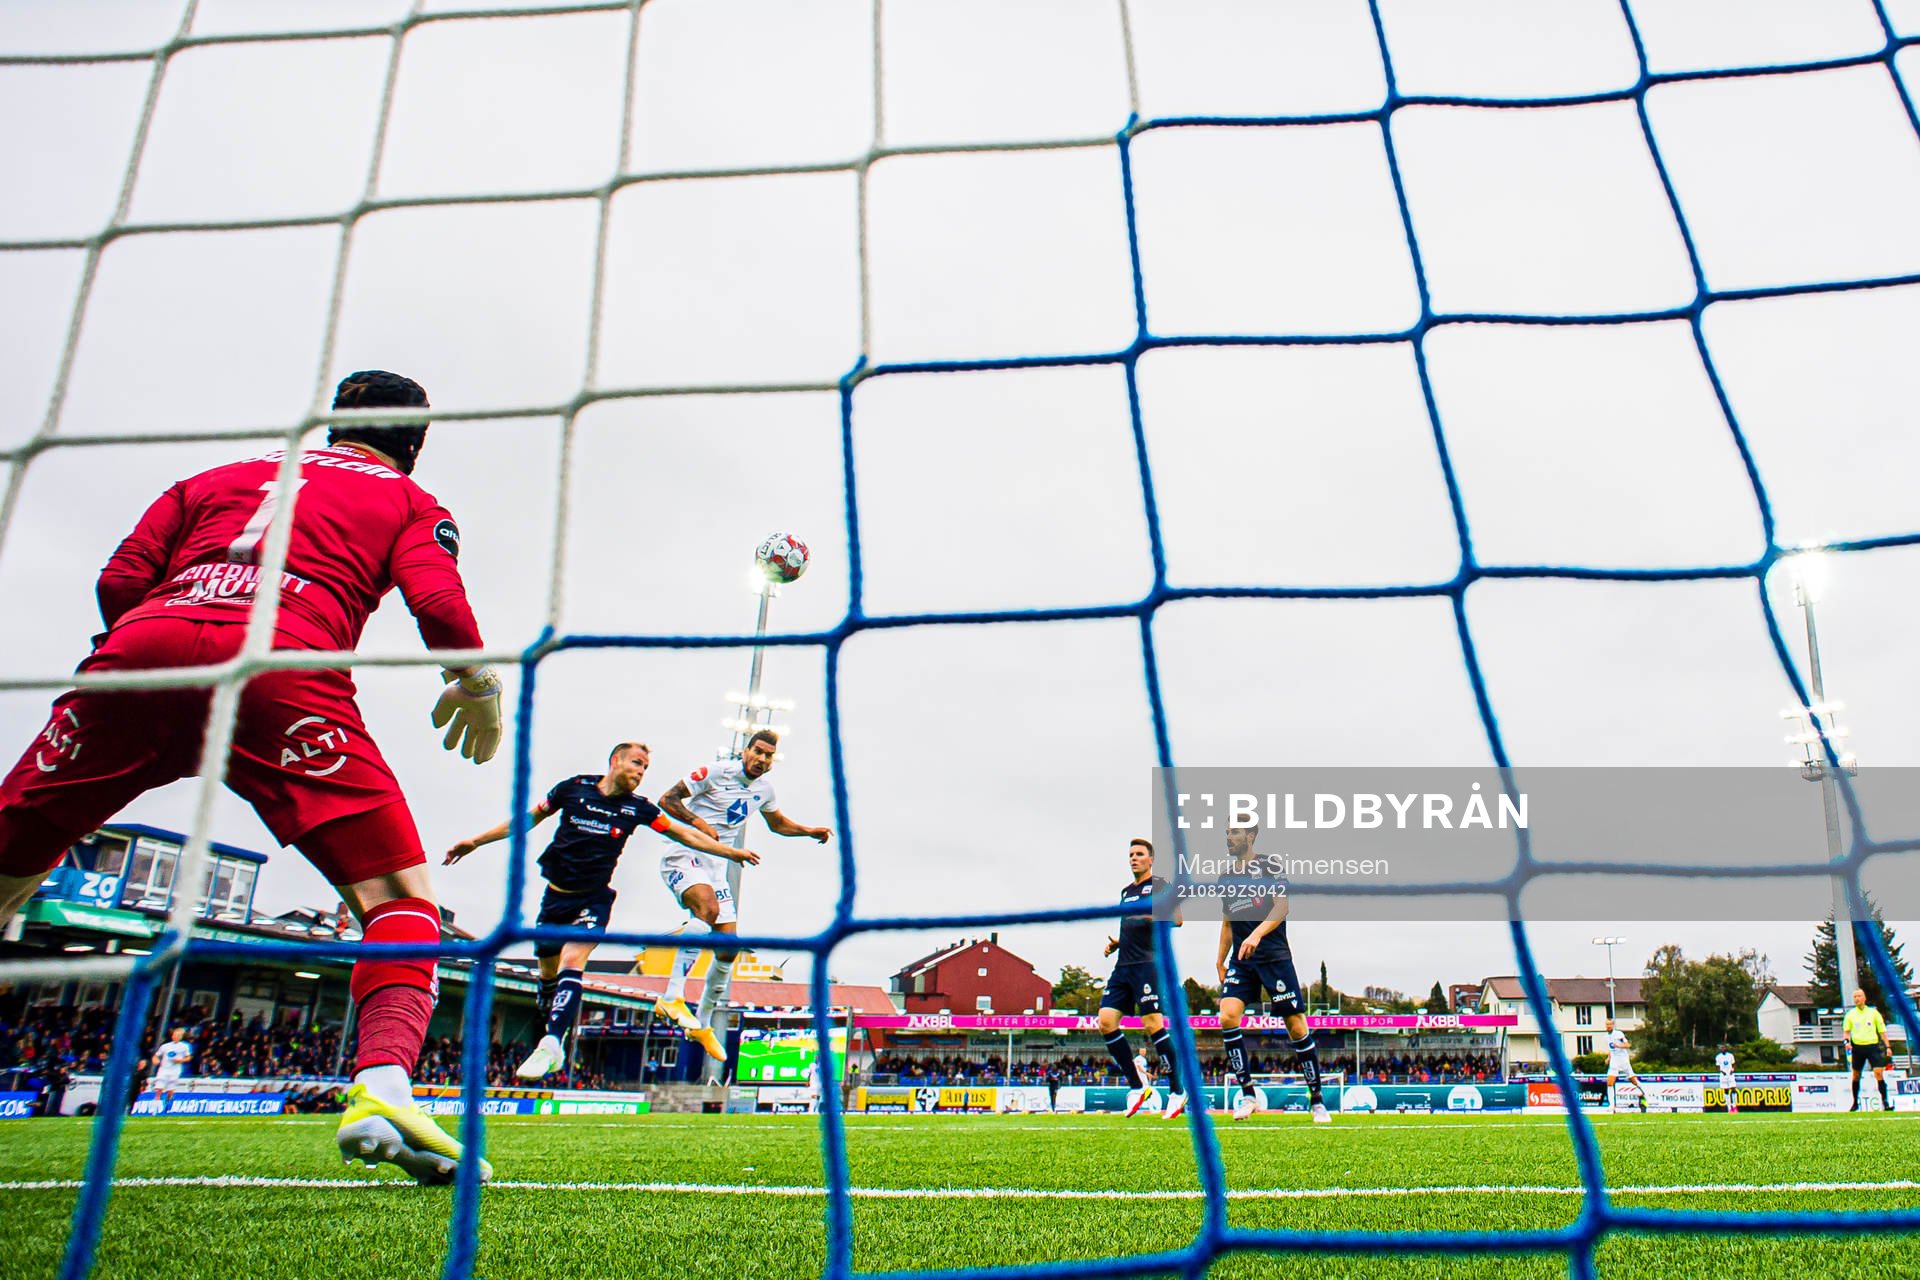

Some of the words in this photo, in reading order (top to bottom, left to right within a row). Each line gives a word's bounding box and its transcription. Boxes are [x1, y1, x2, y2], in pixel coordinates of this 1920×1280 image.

[439, 528, 459, 542] alt
[42, 722, 82, 760] ALTI
[281, 727, 349, 767] ALTI
[570, 815, 611, 830] SpareBank
[1272, 992, 1296, 1003] olivita
[976, 1017, 1018, 1026] SETTER
[1024, 1017, 1055, 1026] SPOR
[1314, 1017, 1357, 1027] SETTER
[1363, 1017, 1394, 1026] SPOR
[945, 1089, 985, 1103] Anus
[1661, 1094, 1678, 1102] TRIO
[1680, 1094, 1695, 1102] HUS
[1704, 1087, 1791, 1107] BUNNPRIS
